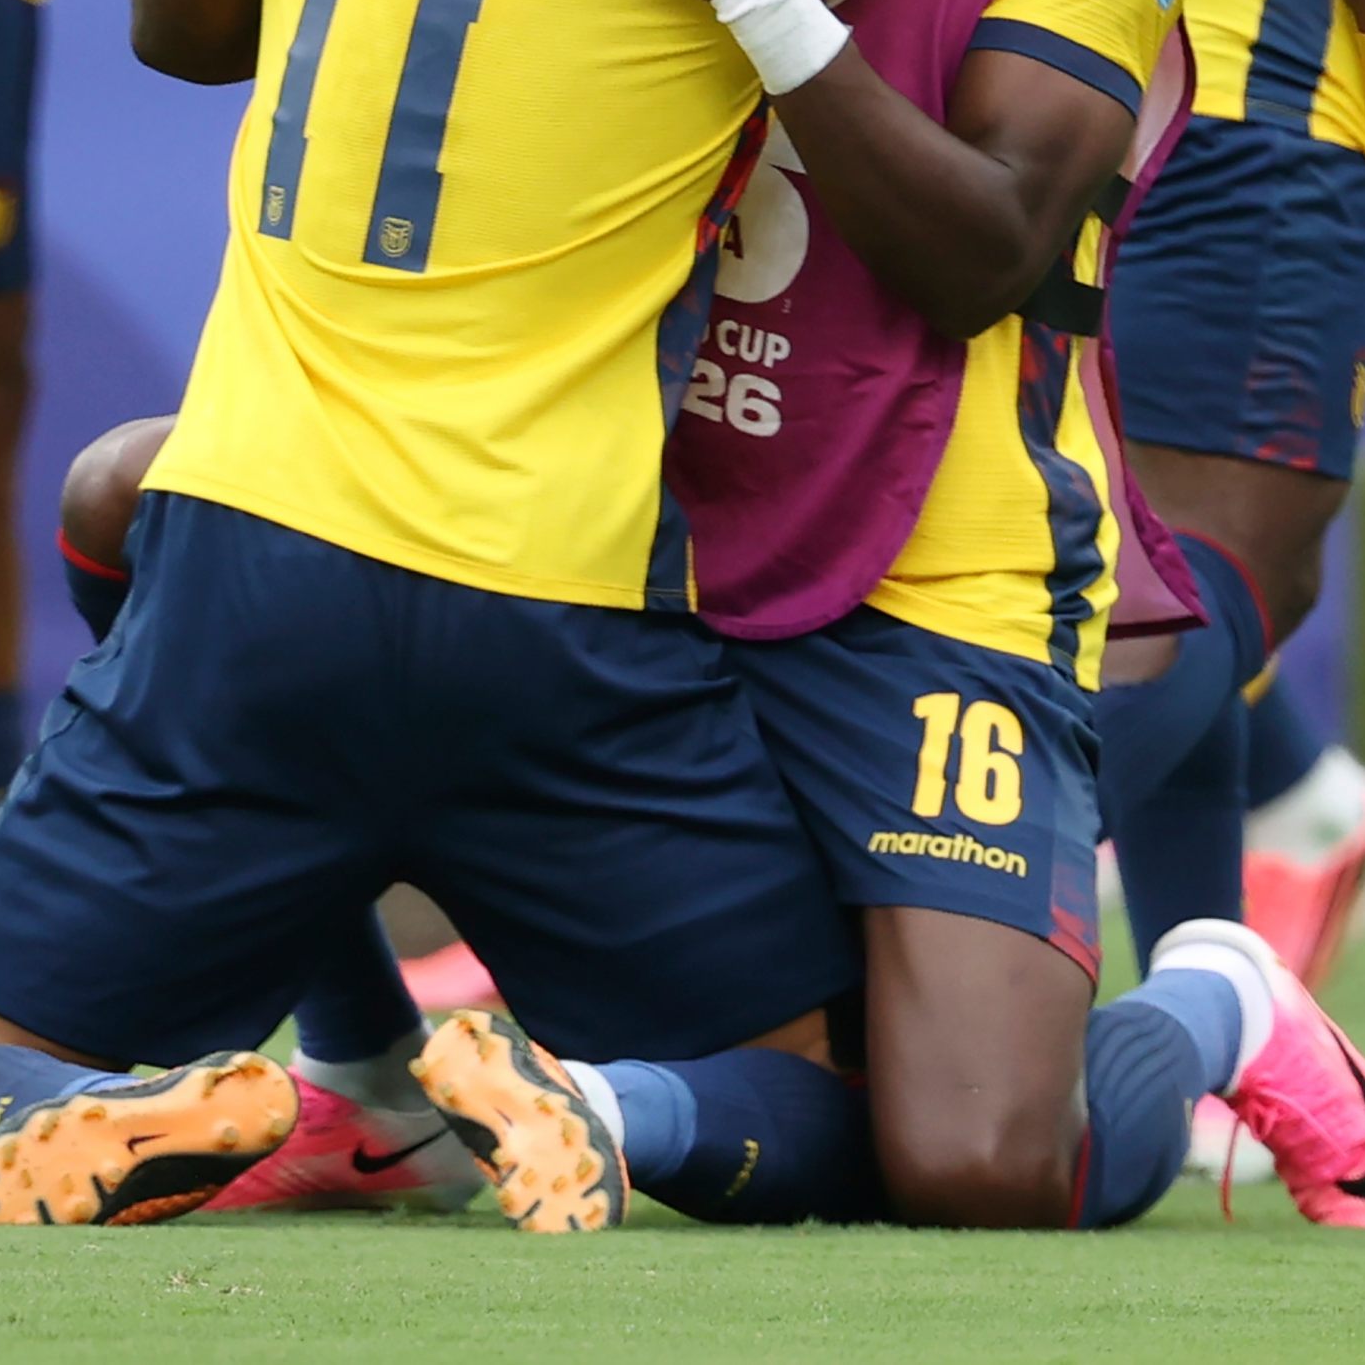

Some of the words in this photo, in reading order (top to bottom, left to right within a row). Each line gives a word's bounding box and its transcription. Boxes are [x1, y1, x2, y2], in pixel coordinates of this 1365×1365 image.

[715, 319, 791, 369] CUP
[911, 692, 1024, 826] 16
[867, 831, 1028, 878] marathon
